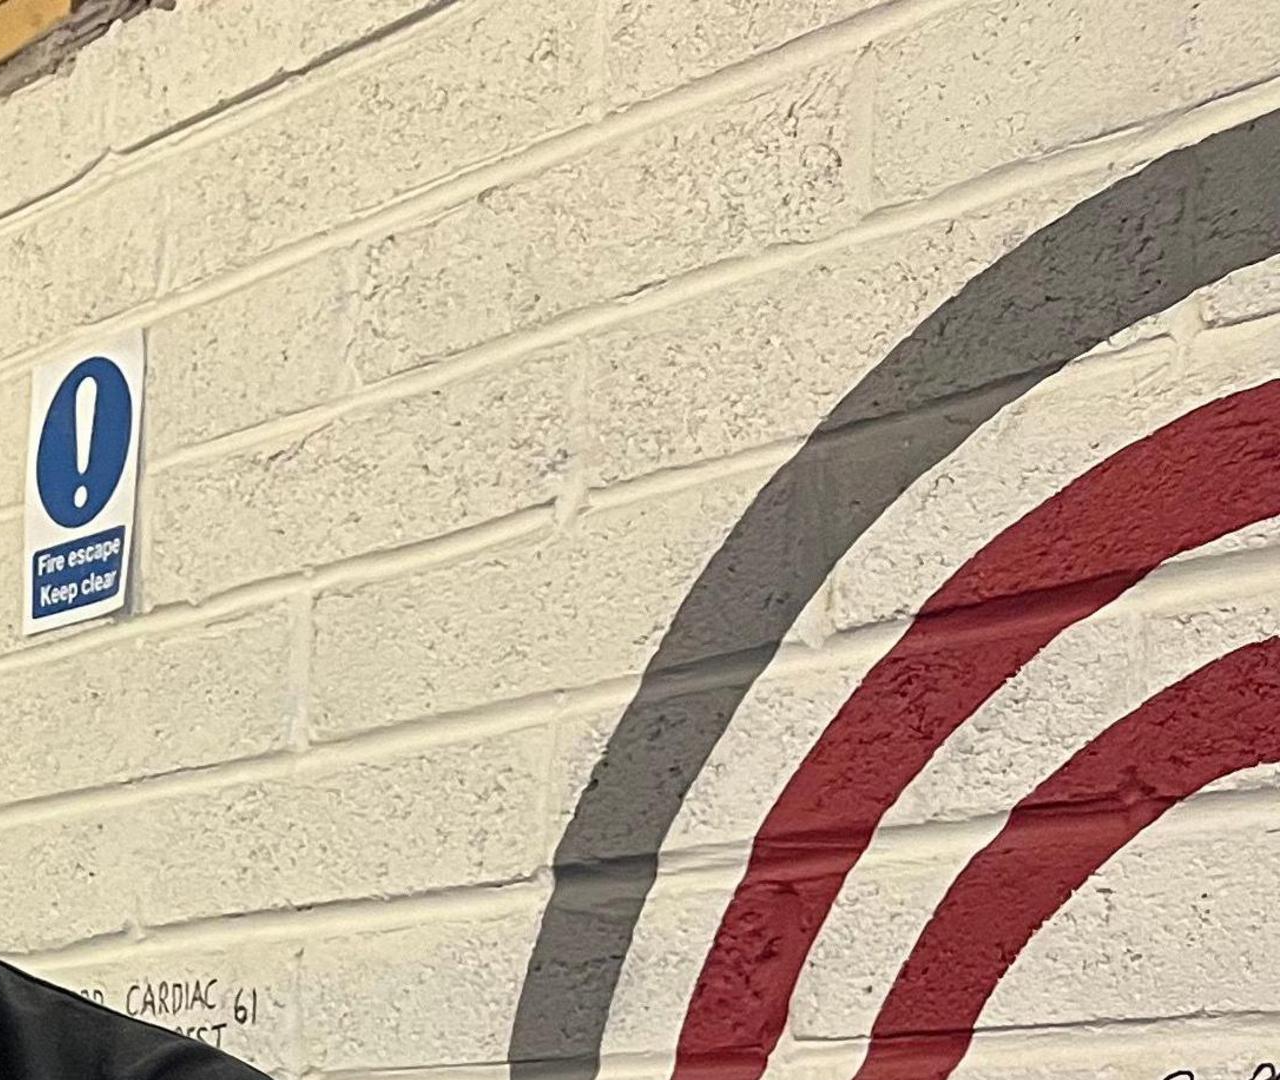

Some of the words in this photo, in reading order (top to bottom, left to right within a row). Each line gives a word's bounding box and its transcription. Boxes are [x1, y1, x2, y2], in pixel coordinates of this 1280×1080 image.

[37, 553, 65, 576] Fire
[68, 538, 121, 568] escape
[40, 582, 78, 607] Keep
[81, 570, 117, 595] clear
[126, 978, 218, 1017] CARDIAC
